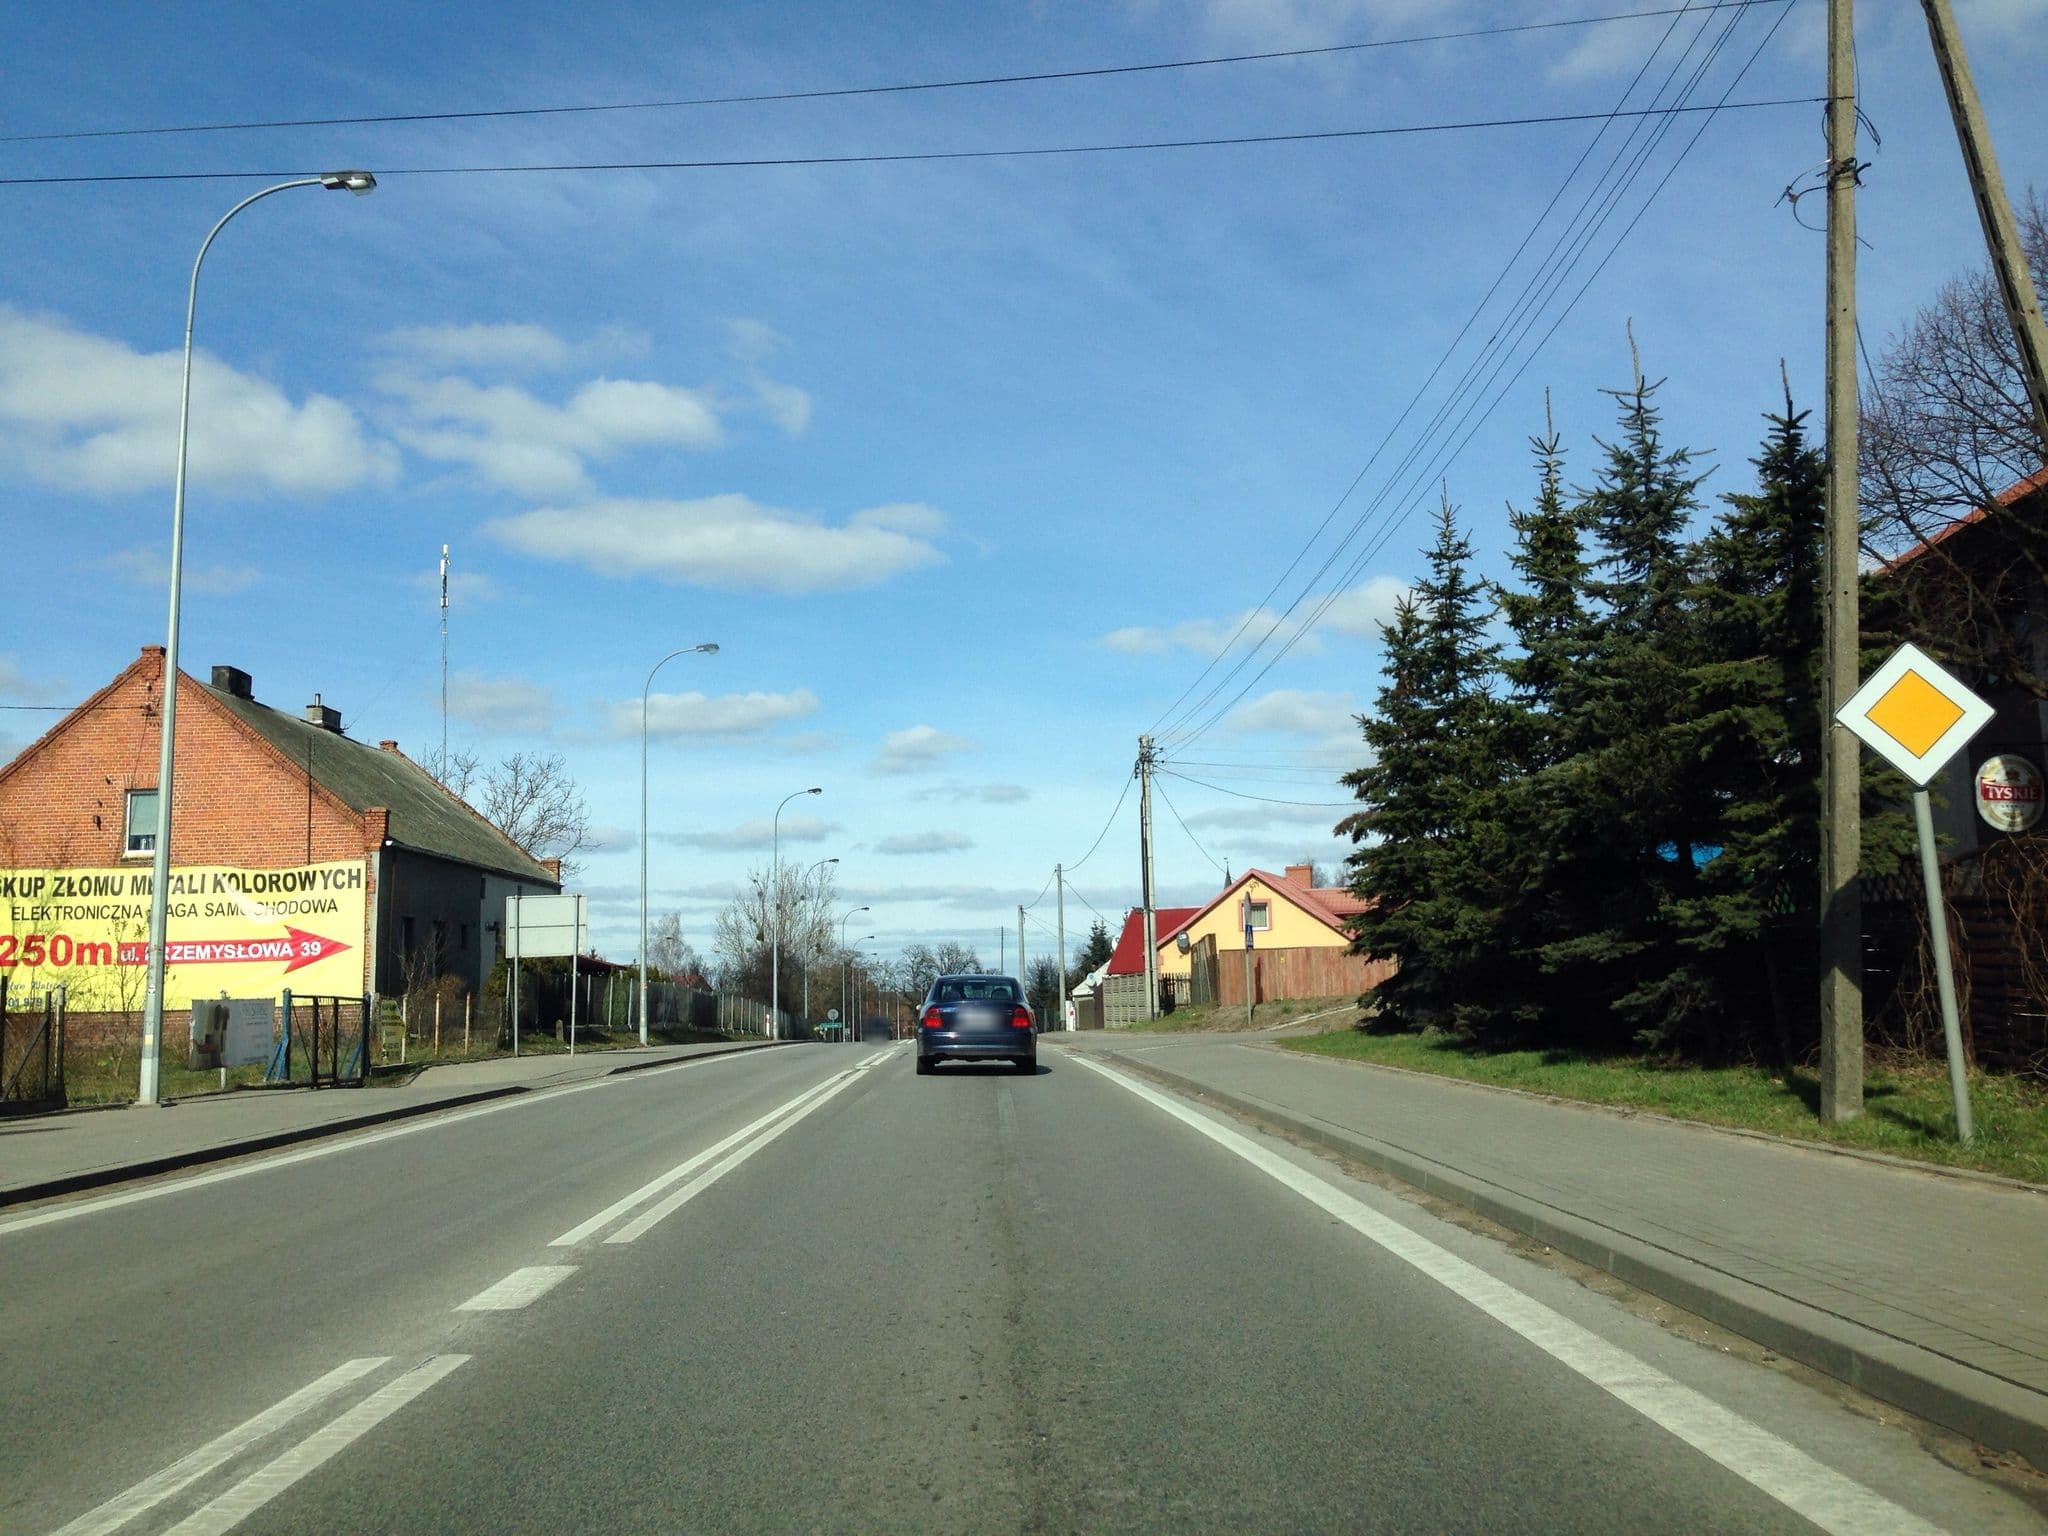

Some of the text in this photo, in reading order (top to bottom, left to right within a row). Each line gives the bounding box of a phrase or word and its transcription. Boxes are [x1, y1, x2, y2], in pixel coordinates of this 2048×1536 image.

[1986, 785, 2039, 799] TYSKIE
[0, 876, 45, 898] KUP
[52, 874, 125, 898] ZŁOMU
[212, 868, 362, 894] KOLOROWYCH
[11, 904, 143, 921] ELEKTRONICZNA
[165, 902, 199, 918] AGA
[0, 934, 112, 968] 250m
[120, 946, 140, 962] ul.
[300, 941, 322, 957] 39
